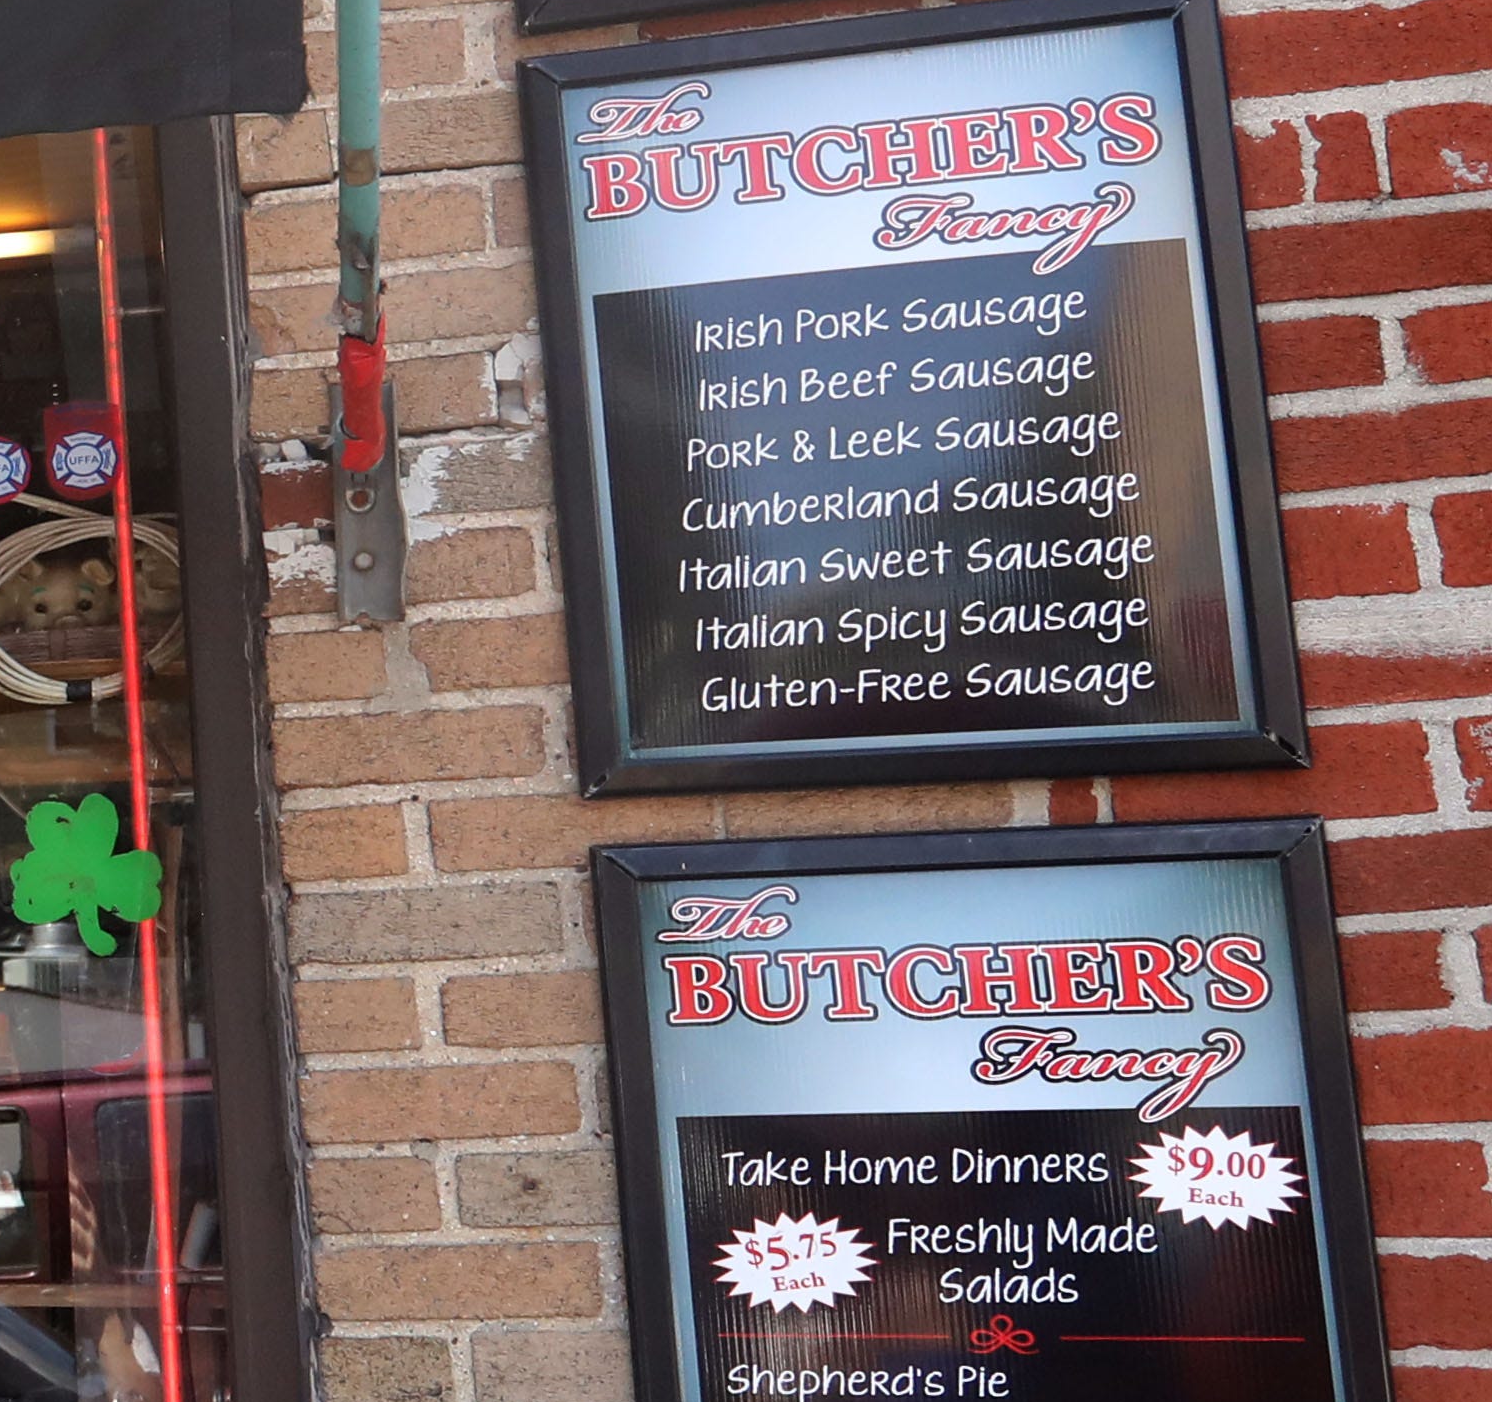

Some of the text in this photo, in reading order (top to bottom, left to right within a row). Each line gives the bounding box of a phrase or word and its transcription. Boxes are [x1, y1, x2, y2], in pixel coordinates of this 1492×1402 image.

[575, 81, 711, 144] The
[583, 93, 1163, 221] BUTCHER'S
[875, 182, 1134, 275] Fancy
[901, 288, 1086, 340] Sausage
[799, 363, 898, 402] Beef
[909, 347, 1095, 398] Sausage
[793, 433, 815, 461] &
[830, 419, 921, 460] Leek
[934, 408, 1121, 457] Sausage
[69, 456, 99, 466] UFFA
[953, 468, 1141, 519] Sausage
[679, 530, 1155, 593] Italian Sweet Sausage
[695, 594, 1149, 655] Italian Spicy Sausage
[965, 655, 1155, 709] Sausage
[656, 885, 797, 943] The
[663, 937, 1272, 1026] BUTCHER'S
[972, 1026, 1244, 1123] Fancy
[720, 1150, 812, 1187] Take
[823, 1150, 940, 1186] Home
[1167, 1144, 1267, 1181] $9.00
[1187, 1188, 1244, 1209] Each
[745, 1231, 839, 1271] $5.75
[1045, 1220, 1159, 1255] Made
[772, 1271, 826, 1292] Each
[939, 1267, 1080, 1305] Salads
[957, 1366, 1010, 1398] Pie
